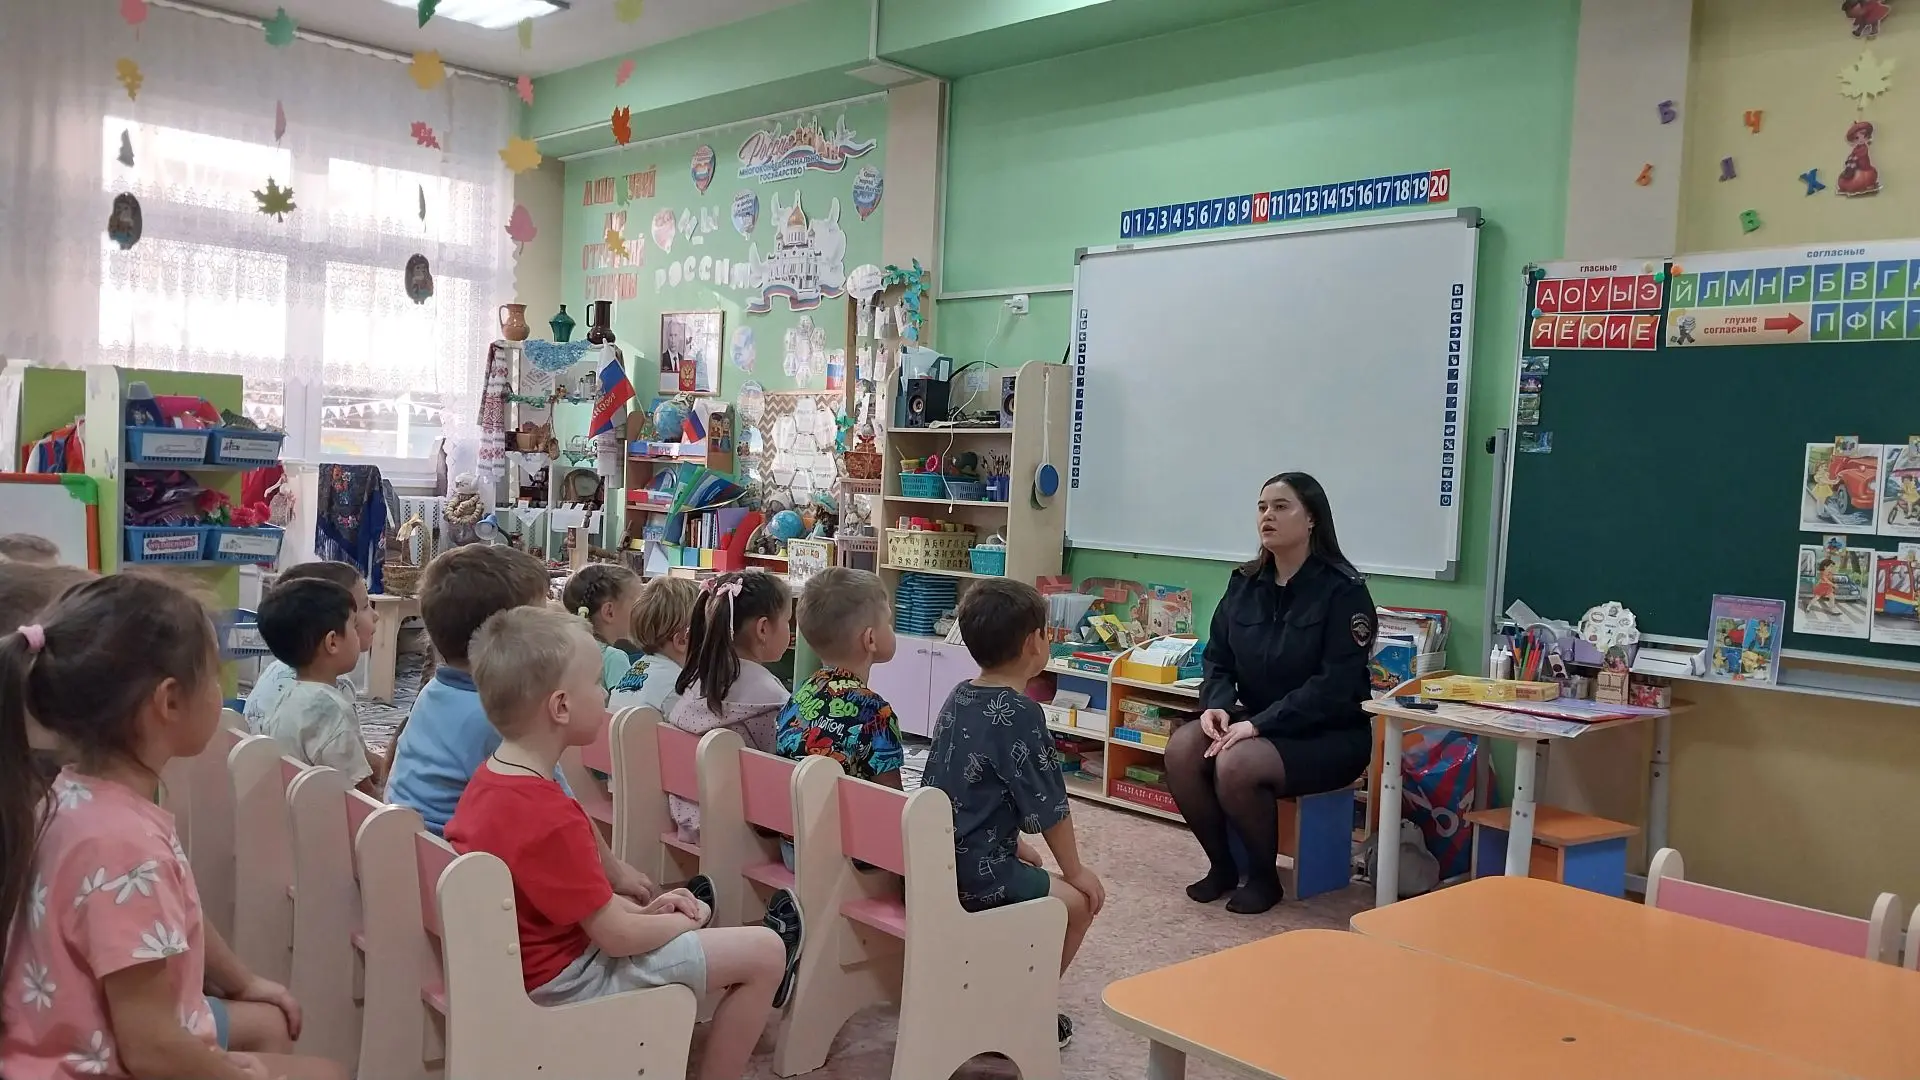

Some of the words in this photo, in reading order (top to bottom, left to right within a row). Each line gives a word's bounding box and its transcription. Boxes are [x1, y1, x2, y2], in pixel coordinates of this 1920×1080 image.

[1658, 100, 1676, 124] Б
[1744, 110, 1763, 133] Ч
[1122, 216, 1131, 234] 0
[1135, 213, 1141, 232] 1
[1146, 212, 1155, 231] 2
[1160, 210, 1168, 229] 3
[1172, 208, 1182, 227] 4
[1186, 207, 1195, 226] 5
[1200, 205, 1209, 224] 6
[1213, 203, 1223, 222] 7
[1227, 201, 1236, 221] 8
[1241, 199, 1250, 220] 9
[1254, 197, 1268, 218] 10
[1271, 195, 1283, 215] 11
[1287, 192, 1301, 213] 12
[1304, 191, 1319, 212] 13
[1322, 189, 1337, 209] 14
[1339, 186, 1354, 207] 15
[1357, 184, 1373, 205] 16
[1375, 182, 1391, 203] 17
[1394, 179, 1410, 201] 18
[1412, 177, 1428, 199] 19
[1429, 174, 1448, 197] 20
[1739, 209, 1760, 234] В
[1807, 248, 1866, 259] согласные
[1580, 264, 1617, 273] гласные
[1541, 289, 1555, 305] А
[1564, 287, 1580, 303] О
[1591, 285, 1605, 303] У
[1613, 284, 1632, 301] Ы
[1641, 283, 1657, 300] Э
[1676, 280, 1692, 302] Й
[1704, 280, 1719, 298] Л
[1729, 279, 1749, 297] М
[1760, 276, 1776, 295] Н
[1789, 275, 1806, 294] Р
[1819, 273, 1836, 292] Б
[1850, 271, 1867, 291] В
[1884, 269, 1899, 289] Г
[1537, 322, 1552, 339] Я
[1561, 320, 1575, 340] Ё
[1581, 323, 1603, 340] Ю
[1610, 323, 1626, 339] И
[1636, 323, 1651, 340] Е
[1703, 325, 1757, 335] согласные
[1724, 316, 1758, 325] глухие
[1816, 312, 1834, 331] П
[1846, 311, 1867, 331] Ф
[1881, 310, 1896, 330] К
